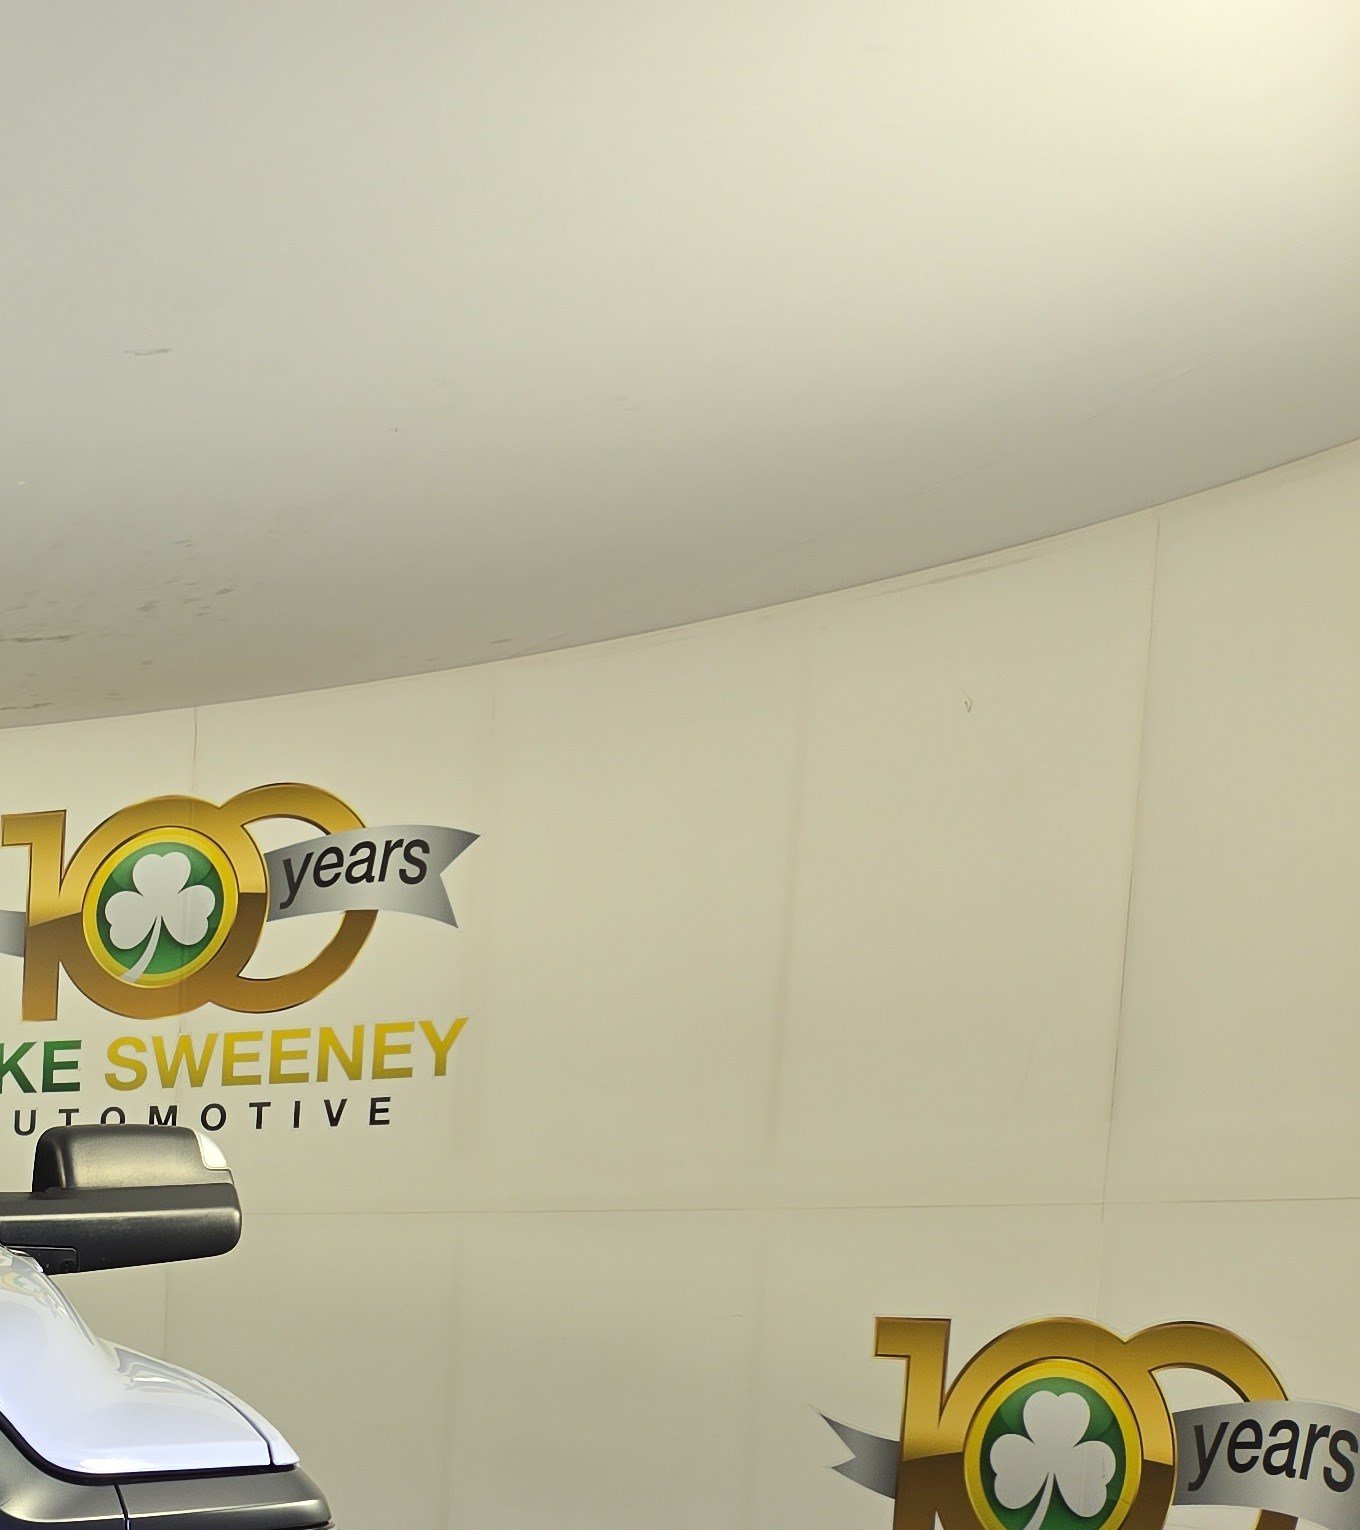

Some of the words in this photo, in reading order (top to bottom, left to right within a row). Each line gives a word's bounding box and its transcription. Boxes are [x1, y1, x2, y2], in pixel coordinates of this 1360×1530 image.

[280, 836, 430, 909] years
[105, 1017, 468, 1091] SWEENEY
[1187, 1416, 1359, 1492] years
